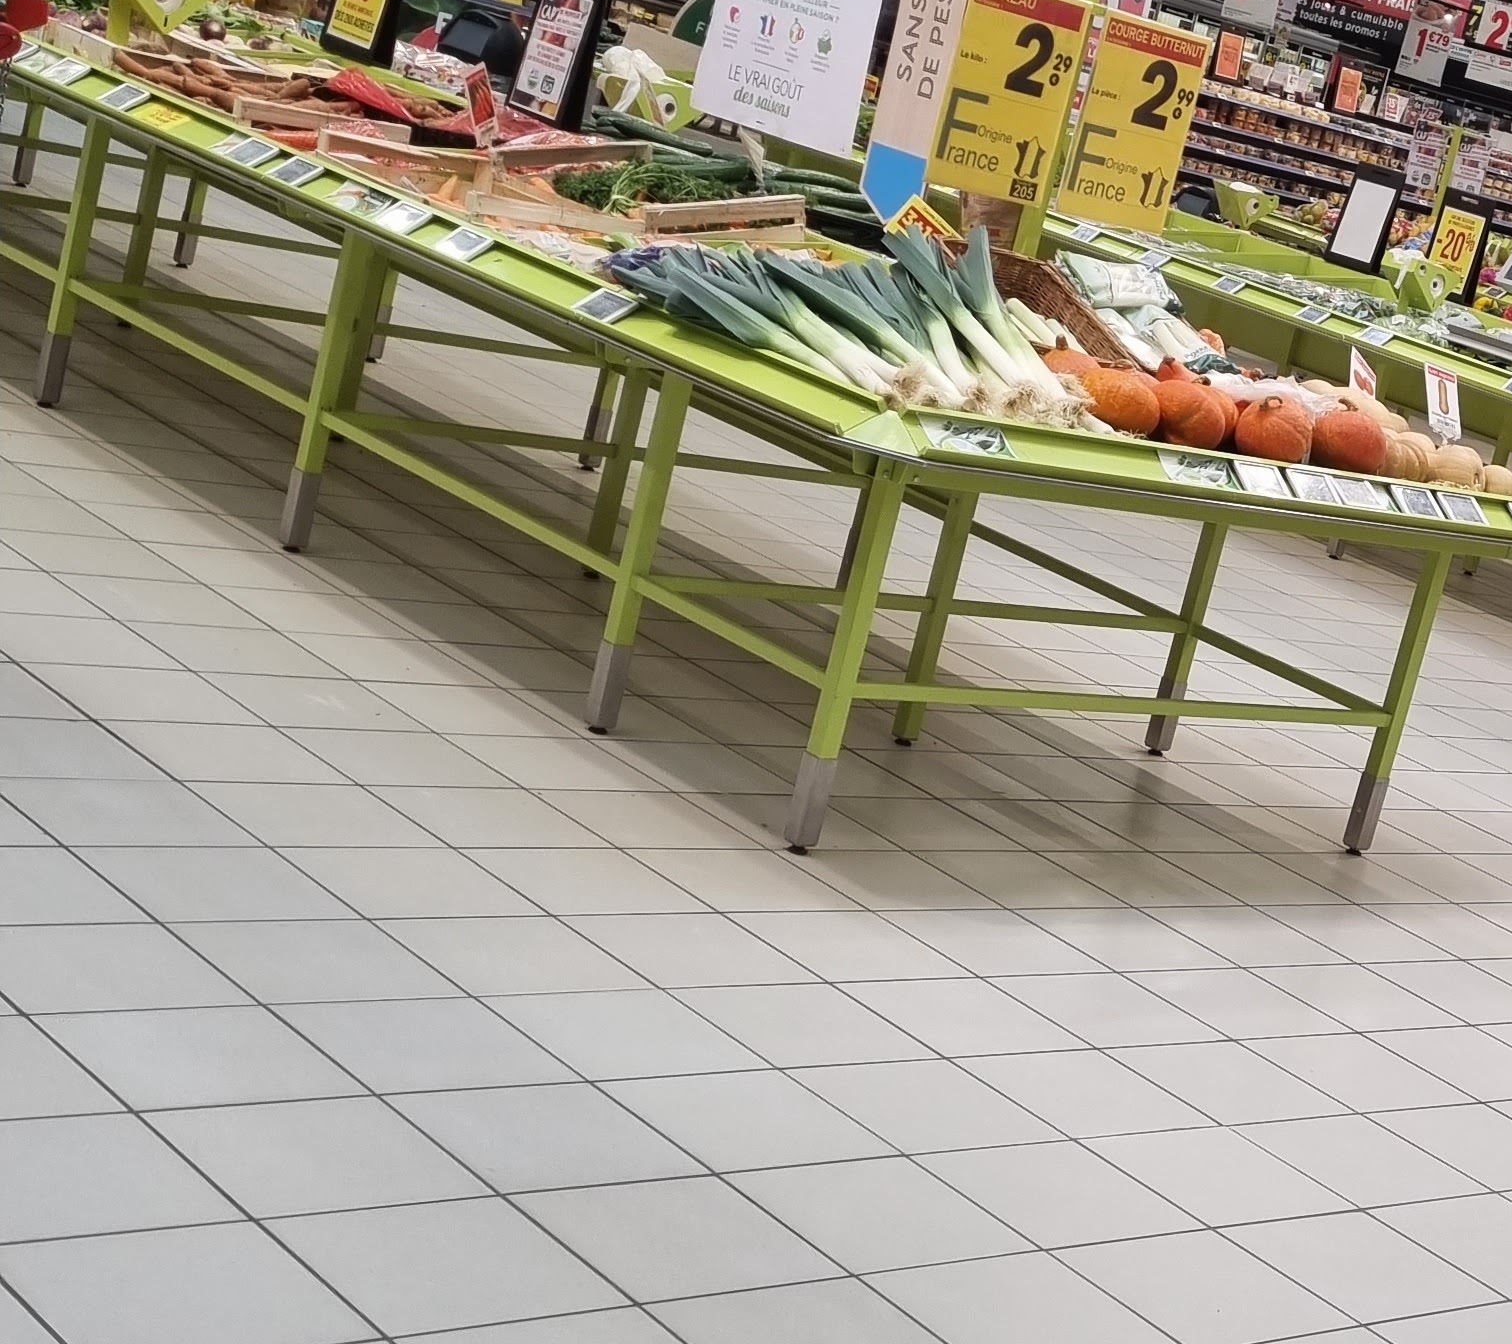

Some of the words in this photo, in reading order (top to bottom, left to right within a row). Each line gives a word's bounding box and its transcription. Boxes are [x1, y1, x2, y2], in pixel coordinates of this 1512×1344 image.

[1300, 8, 1328, 25] toutes
[1330, 15, 1343, 28] les
[1344, 22, 1380, 39] promos
[1351, 9, 1404, 31] cumulable
[1486, 10, 1509, 50] 2
[1109, 21, 1150, 43] COURGE
[1150, 33, 1206, 60] BUTTERNUT
[1415, 28, 1428, 56] 1
[1428, 31, 1450, 47] €79
[1004, 23, 1054, 98] 2
[1053, 54, 1072, 73] 29
[728, 64, 742, 82] LE
[745, 67, 771, 90] VRAI
[772, 76, 805, 101] GOÛT
[917, 56, 941, 100] DE
[733, 86, 753, 105] des
[754, 93, 791, 118] saisons
[1131, 59, 1178, 131] 2
[1177, 88, 1195, 107] 99
[977, 125, 1012, 144] Origine
[1105, 157, 1138, 175] Origine
[1012, 184, 1034, 200] 205
[1437, 228, 1476, 263] -20%
